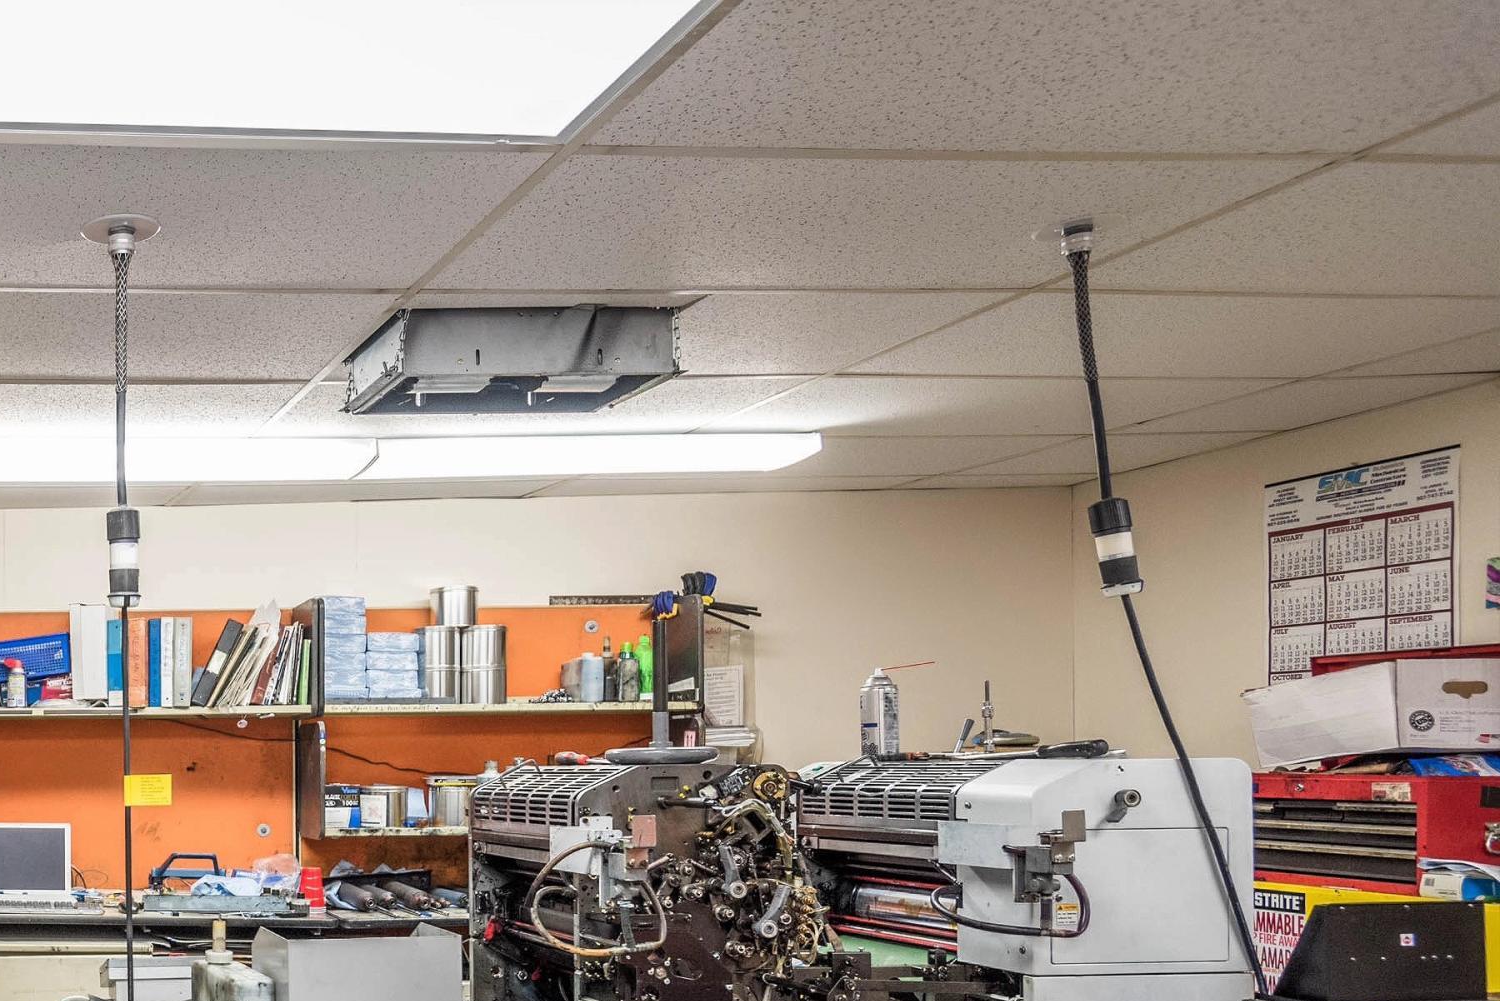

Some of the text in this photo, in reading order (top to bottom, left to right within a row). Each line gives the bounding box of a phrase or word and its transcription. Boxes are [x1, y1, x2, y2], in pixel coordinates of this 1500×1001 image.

[1389, 514, 1420, 525] MARCH
[1327, 524, 1365, 535] FEBRUARY
[1272, 534, 1304, 544] JANUARY
[1389, 566, 1411, 575] JUNE
[1328, 575, 1345, 583] MAY
[1272, 582, 1291, 590] APRIL
[1389, 615, 1433, 625] SEPTEMBER
[1328, 622, 1357, 631] AUGUST
[1255, 892, 1300, 910] STRITE
[1260, 933, 1276, 945] FIRE
